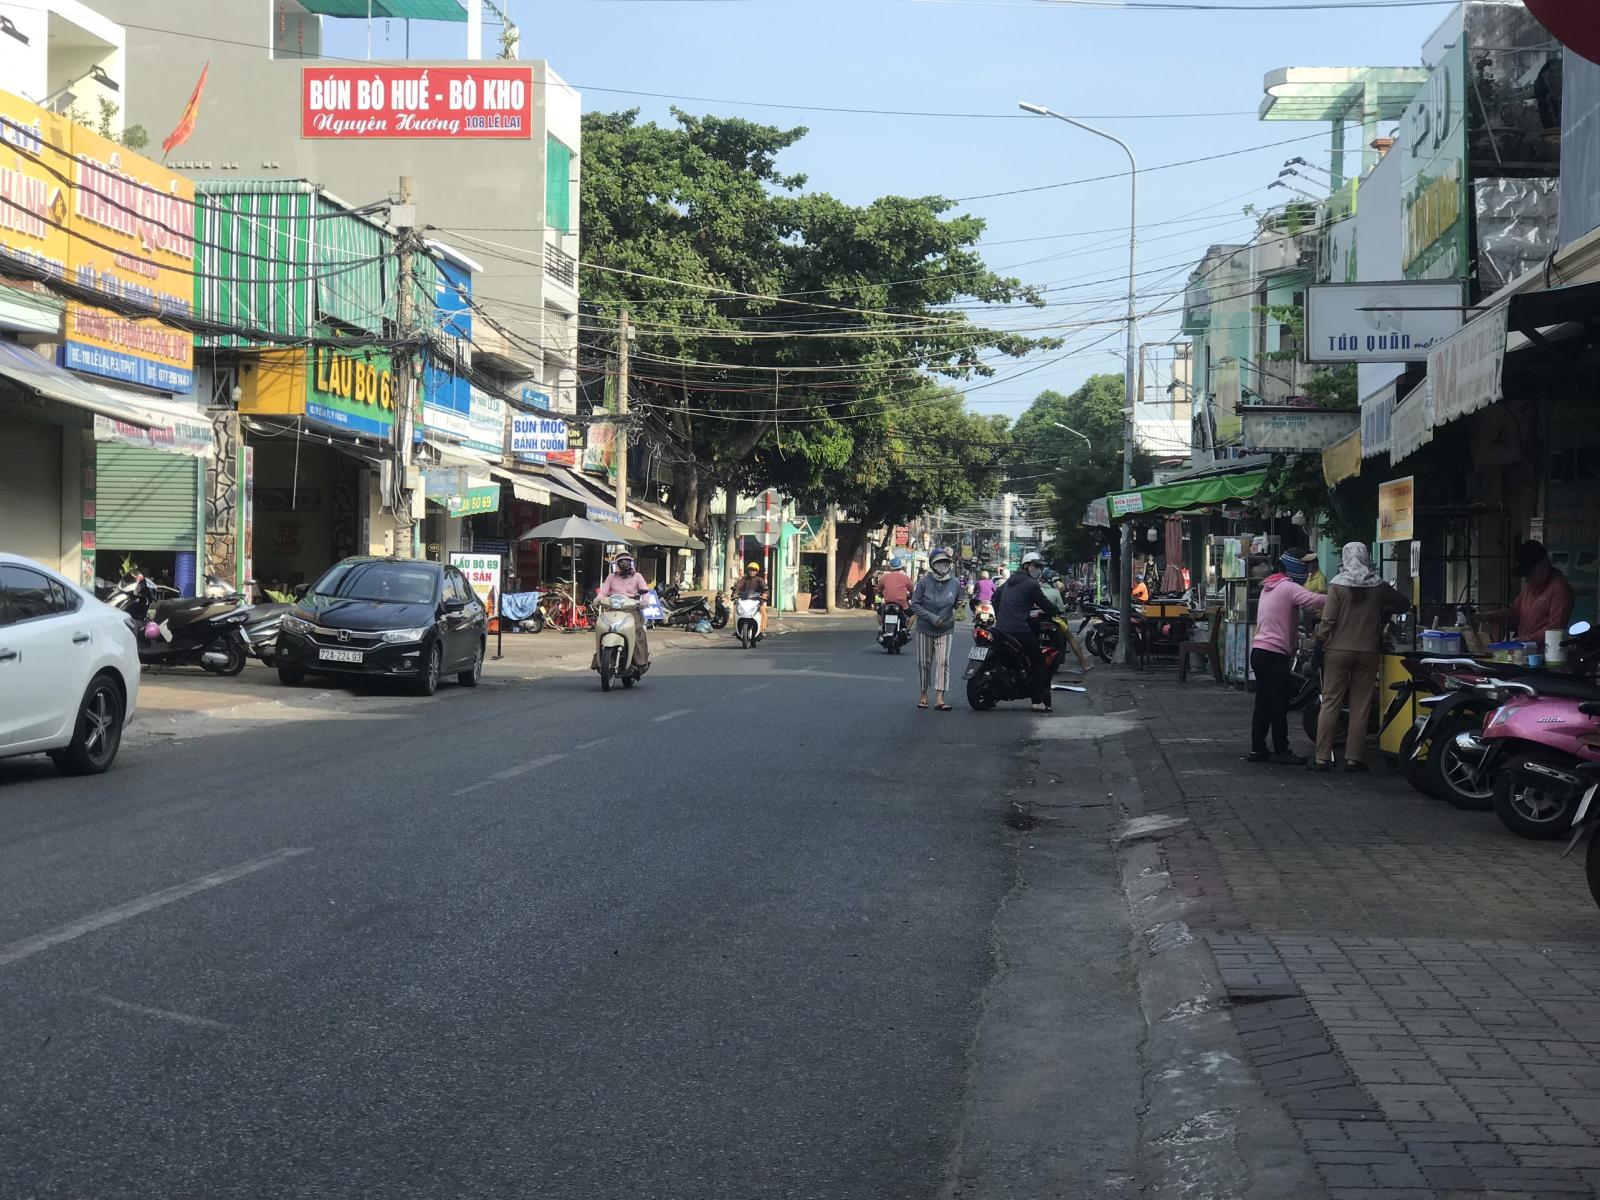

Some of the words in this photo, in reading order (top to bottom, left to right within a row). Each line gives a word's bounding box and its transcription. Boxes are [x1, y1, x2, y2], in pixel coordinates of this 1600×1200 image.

[309, 75, 351, 110] BÚN
[357, 75, 385, 110] BÒ
[391, 70, 429, 110] HUẾ
[449, 75, 477, 110] BÒ
[483, 79, 524, 110] KHO
[395, 113, 461, 134] Hương
[465, 116, 485, 128] 108
[488, 113, 501, 128] LÊ
[504, 116, 521, 128] LAI
[1328, 333, 1358, 351] TÁO
[1366, 332, 1410, 352] QUÂN
[514, 418, 536, 433] BÚN
[514, 434, 537, 449] BÁNH
[487, 560, 499, 570] 69
